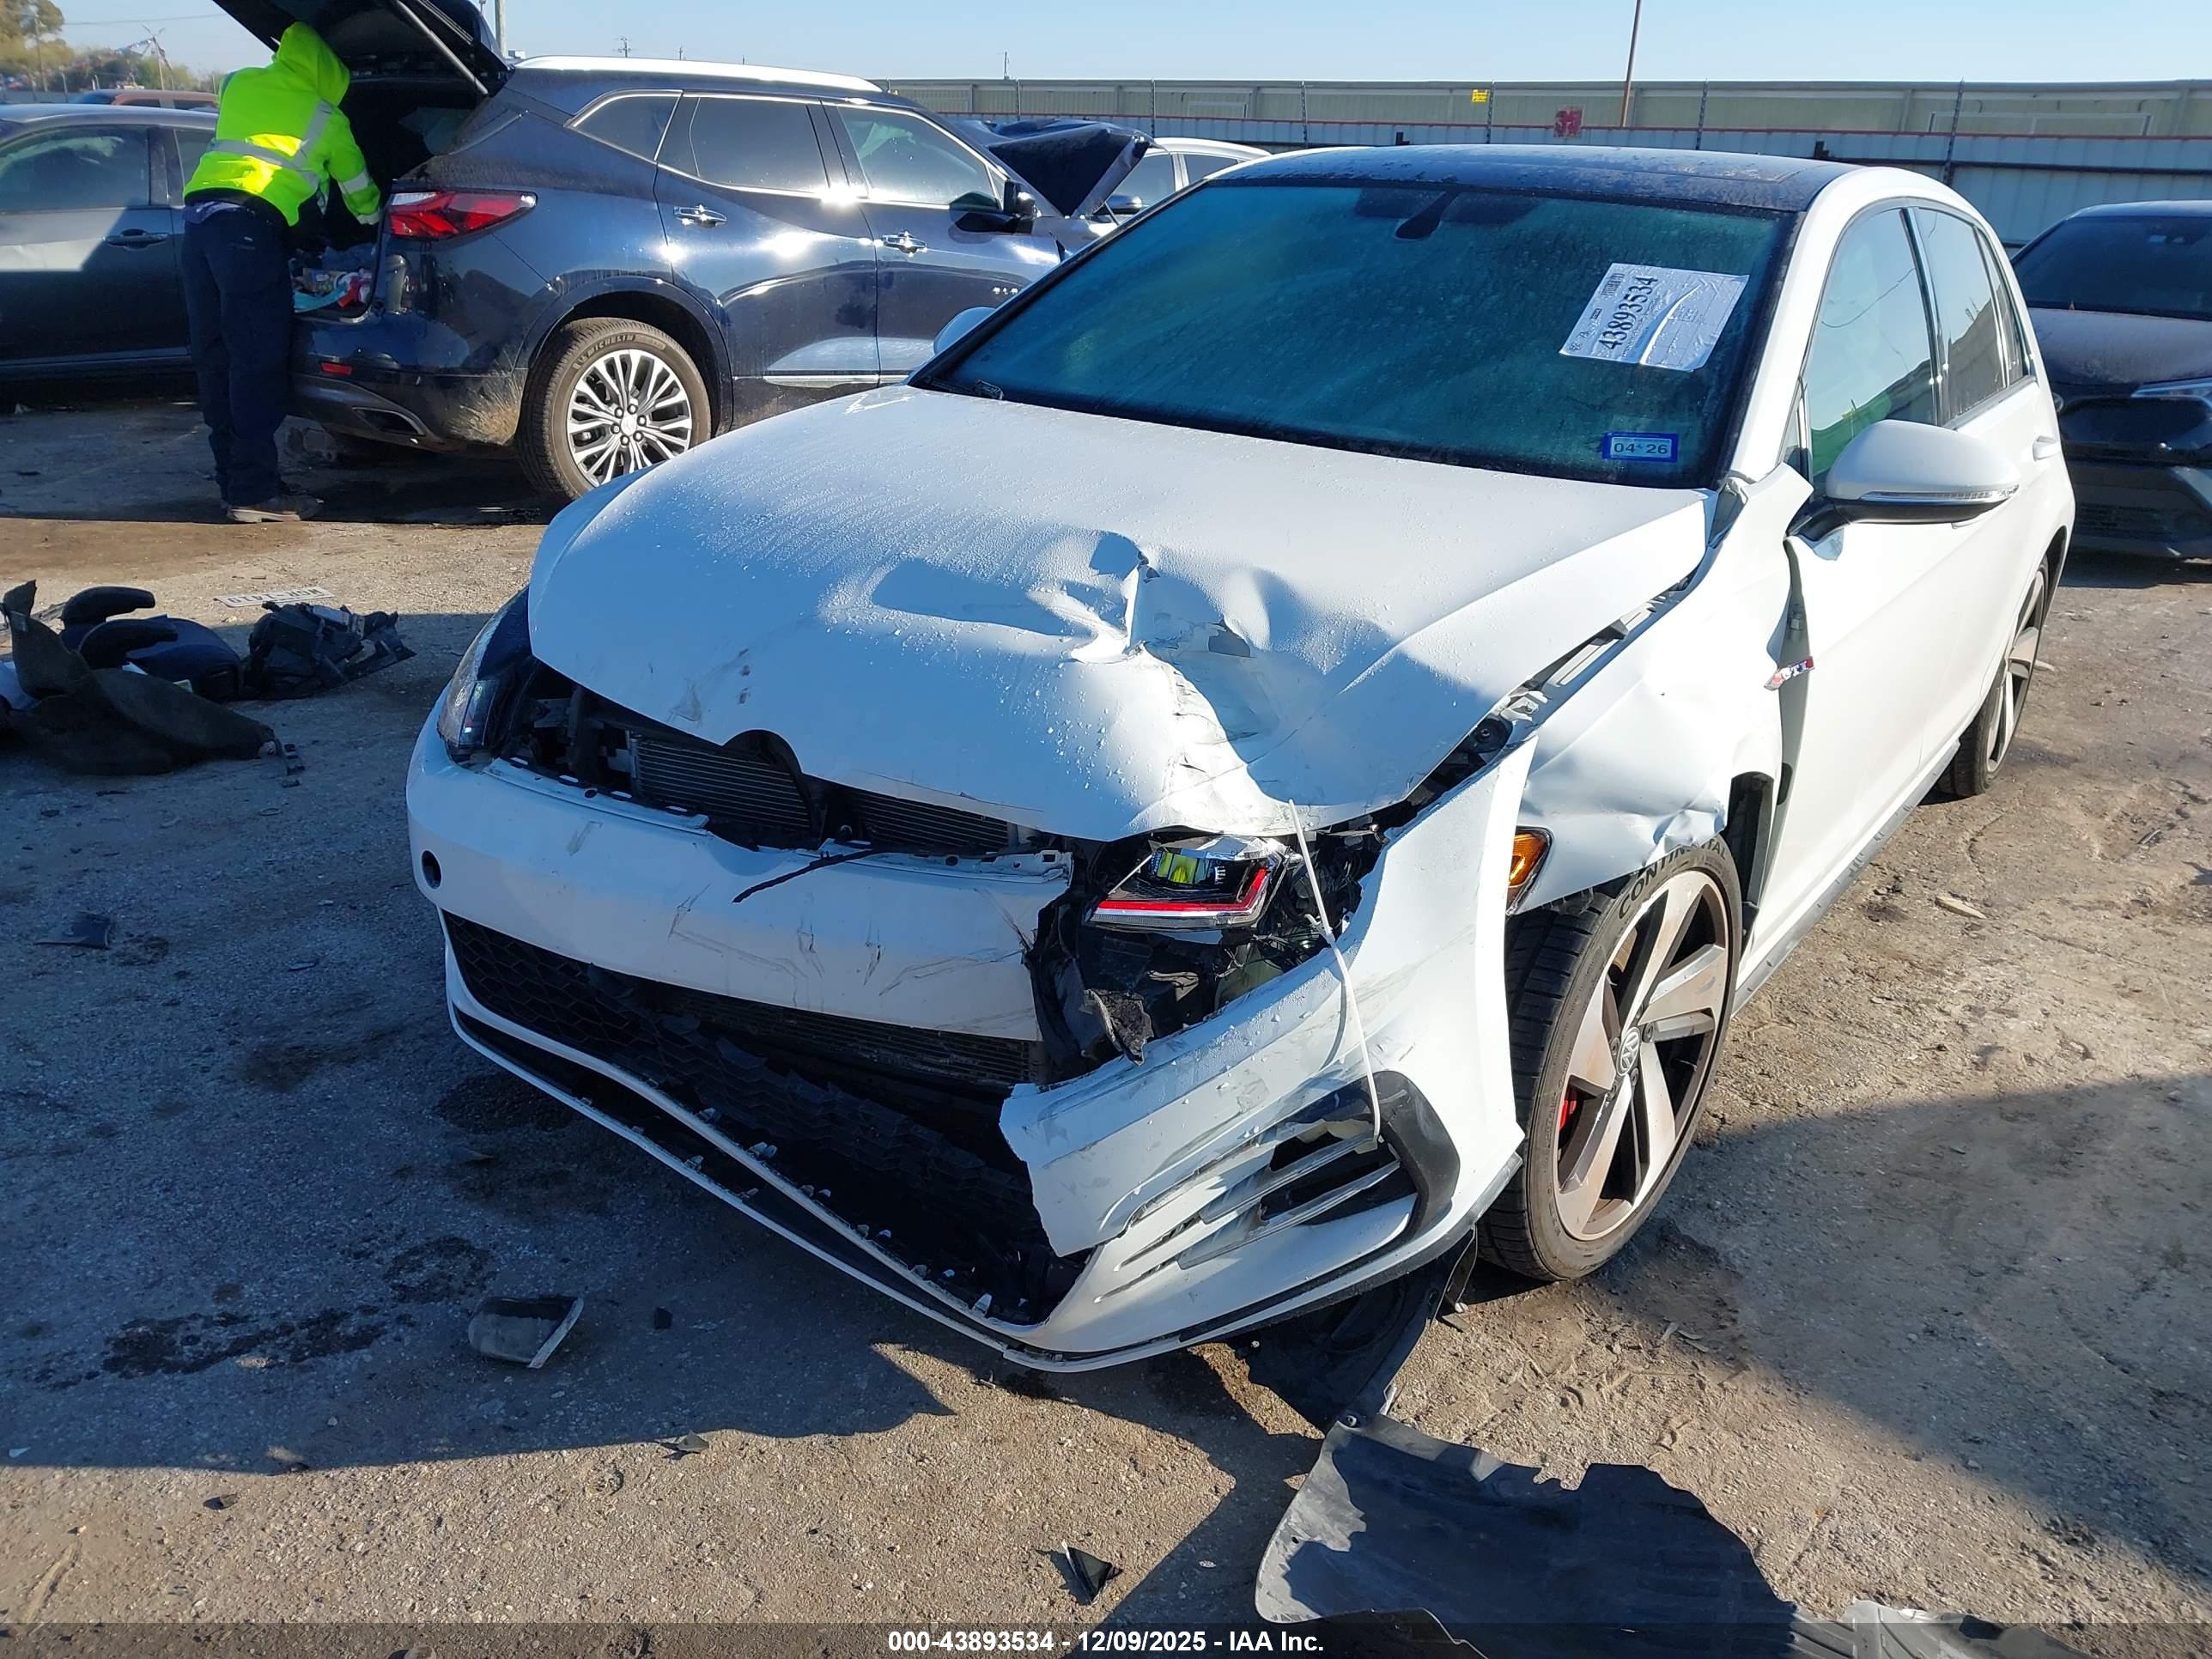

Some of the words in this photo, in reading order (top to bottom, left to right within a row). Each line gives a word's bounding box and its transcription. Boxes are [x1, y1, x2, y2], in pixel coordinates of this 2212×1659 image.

[1599, 276, 1658, 350] 43893534
[586, 334, 635, 358] MICHELIN
[1614, 442, 1636, 453] 04
[1646, 444, 1668, 454] 26
